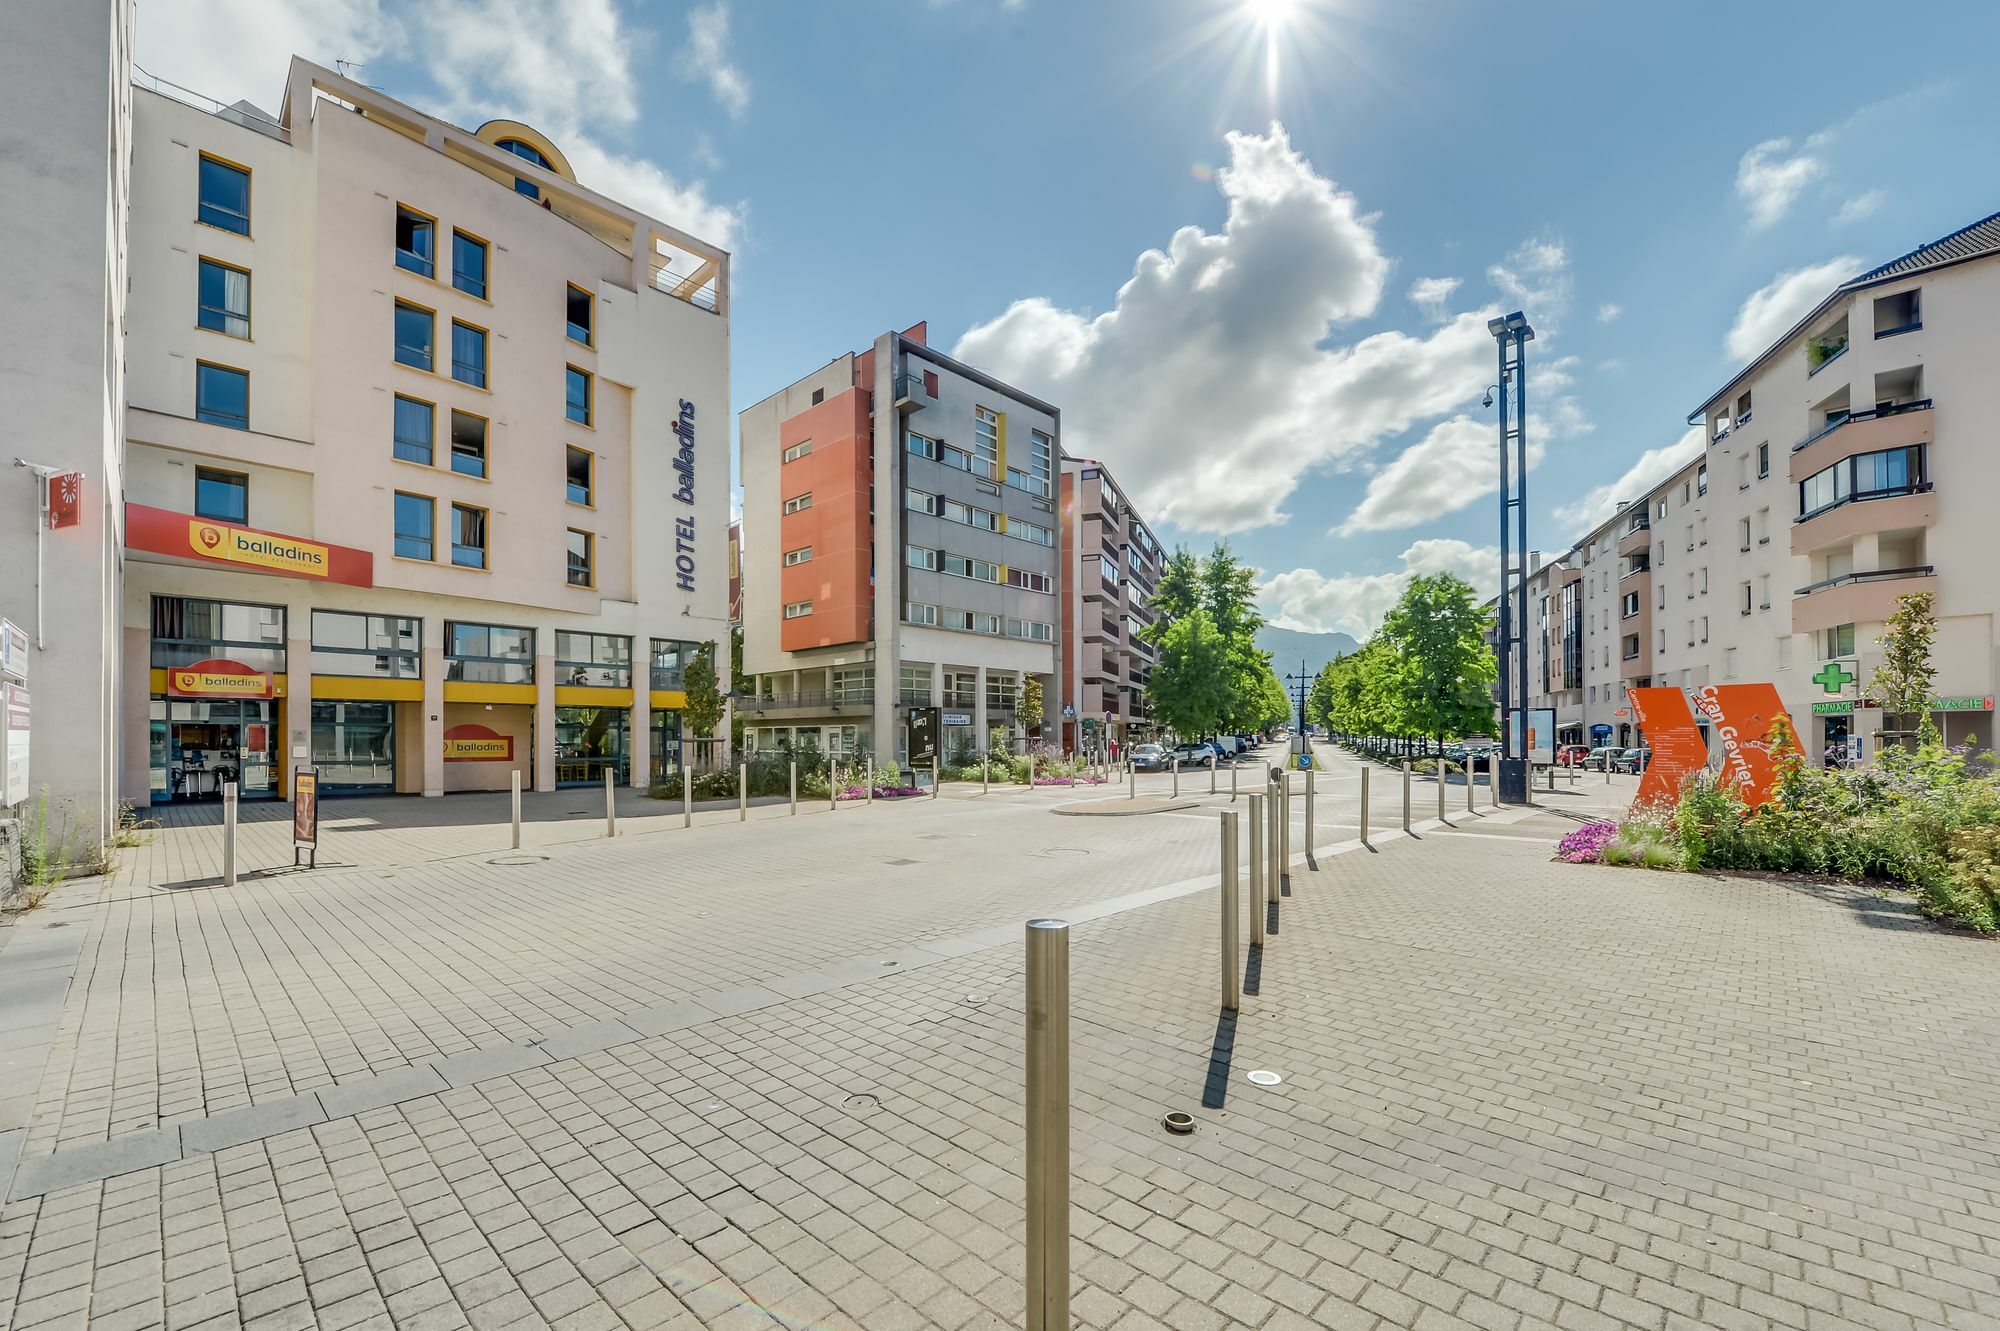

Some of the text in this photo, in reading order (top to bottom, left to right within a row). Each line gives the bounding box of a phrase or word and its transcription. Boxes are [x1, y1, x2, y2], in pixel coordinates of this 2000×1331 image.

[671, 398, 696, 593] HOTEL balladins
[237, 536, 322, 564] balladins
[205, 677, 262, 688] balladins
[1812, 702, 1852, 713] PHARMACIE
[1701, 685, 1725, 723] Cran
[1719, 726, 1756, 788] Gevrier
[456, 743, 505, 752] balladins
